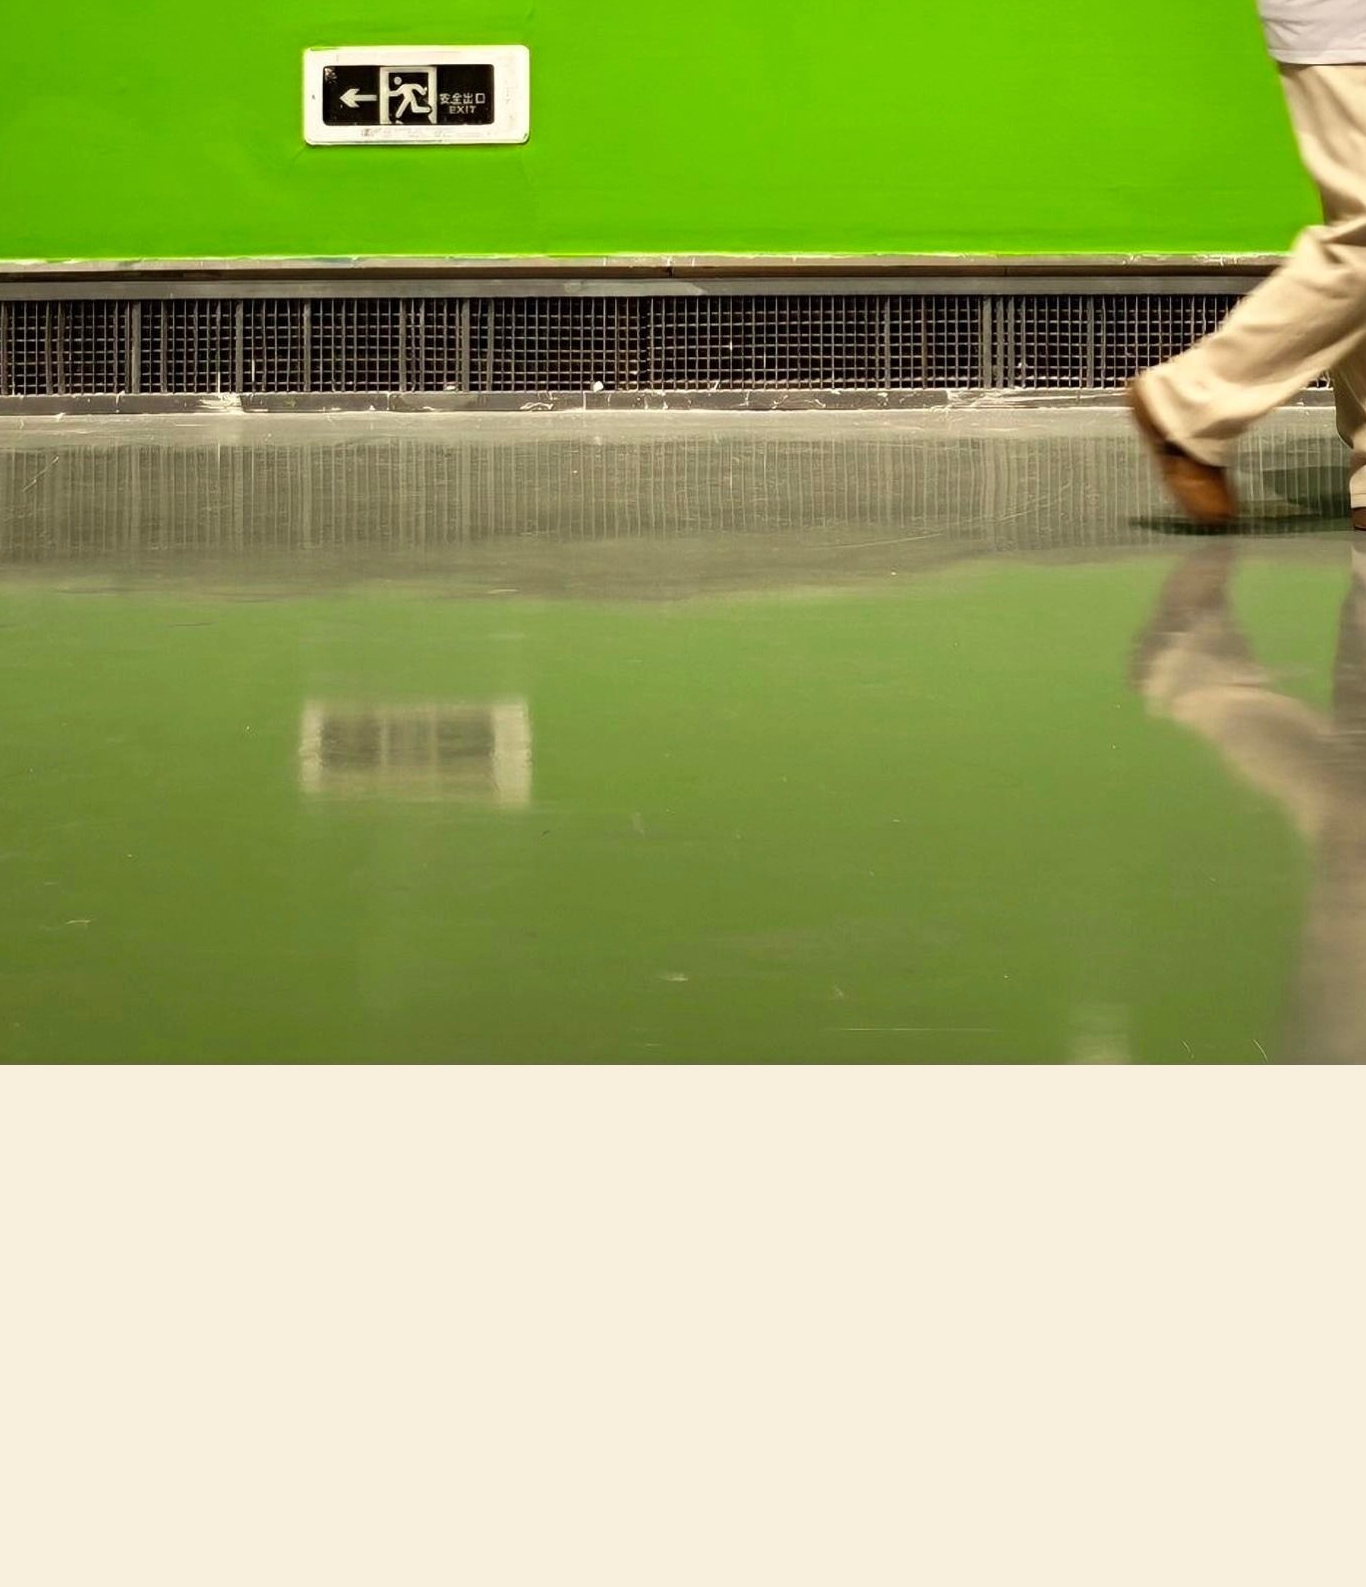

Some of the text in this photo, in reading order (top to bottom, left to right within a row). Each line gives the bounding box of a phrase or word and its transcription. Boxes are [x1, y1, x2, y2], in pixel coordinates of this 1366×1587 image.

[439, 92, 486, 105] 安全出口
[449, 105, 476, 114] EXIT
